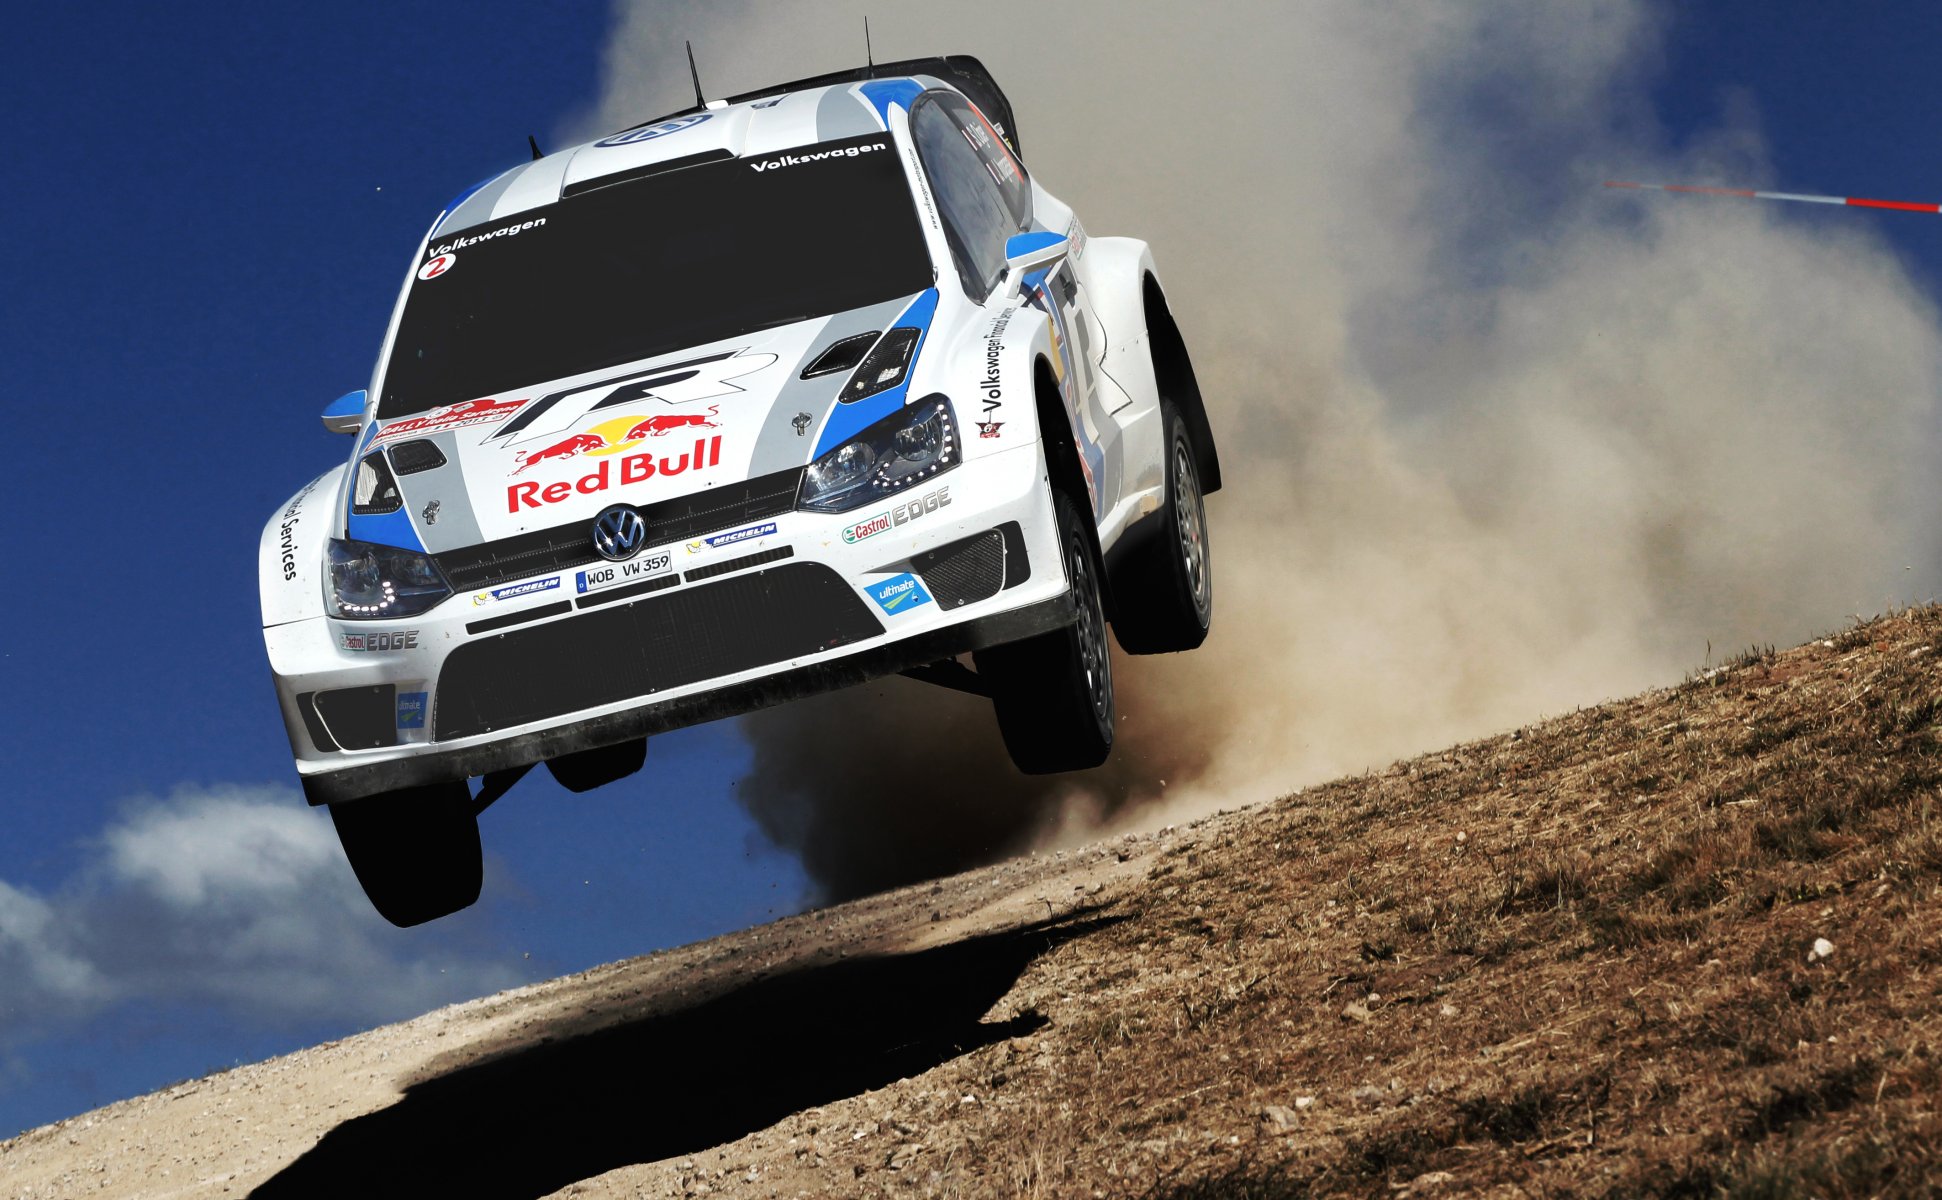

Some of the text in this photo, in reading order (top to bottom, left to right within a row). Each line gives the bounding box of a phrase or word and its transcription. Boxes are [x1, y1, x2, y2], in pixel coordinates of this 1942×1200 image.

[749, 143, 887, 173] Volkswagen
[428, 217, 547, 259] Volkswagen
[426, 256, 447, 278] 2
[980, 338, 1005, 413] Volkswagen
[378, 420, 427, 437] RALLY
[507, 435, 723, 514] Red Bull
[855, 485, 953, 539] Castrol EDGE
[280, 518, 300, 582] Services
[712, 524, 776, 546] MICHELIN
[586, 568, 615, 586] WOB
[622, 561, 641, 577] VW
[643, 555, 669, 572] 359
[497, 578, 560, 599] MICHELIN
[878, 579, 915, 599] ultimate
[367, 629, 420, 652] EDGE
